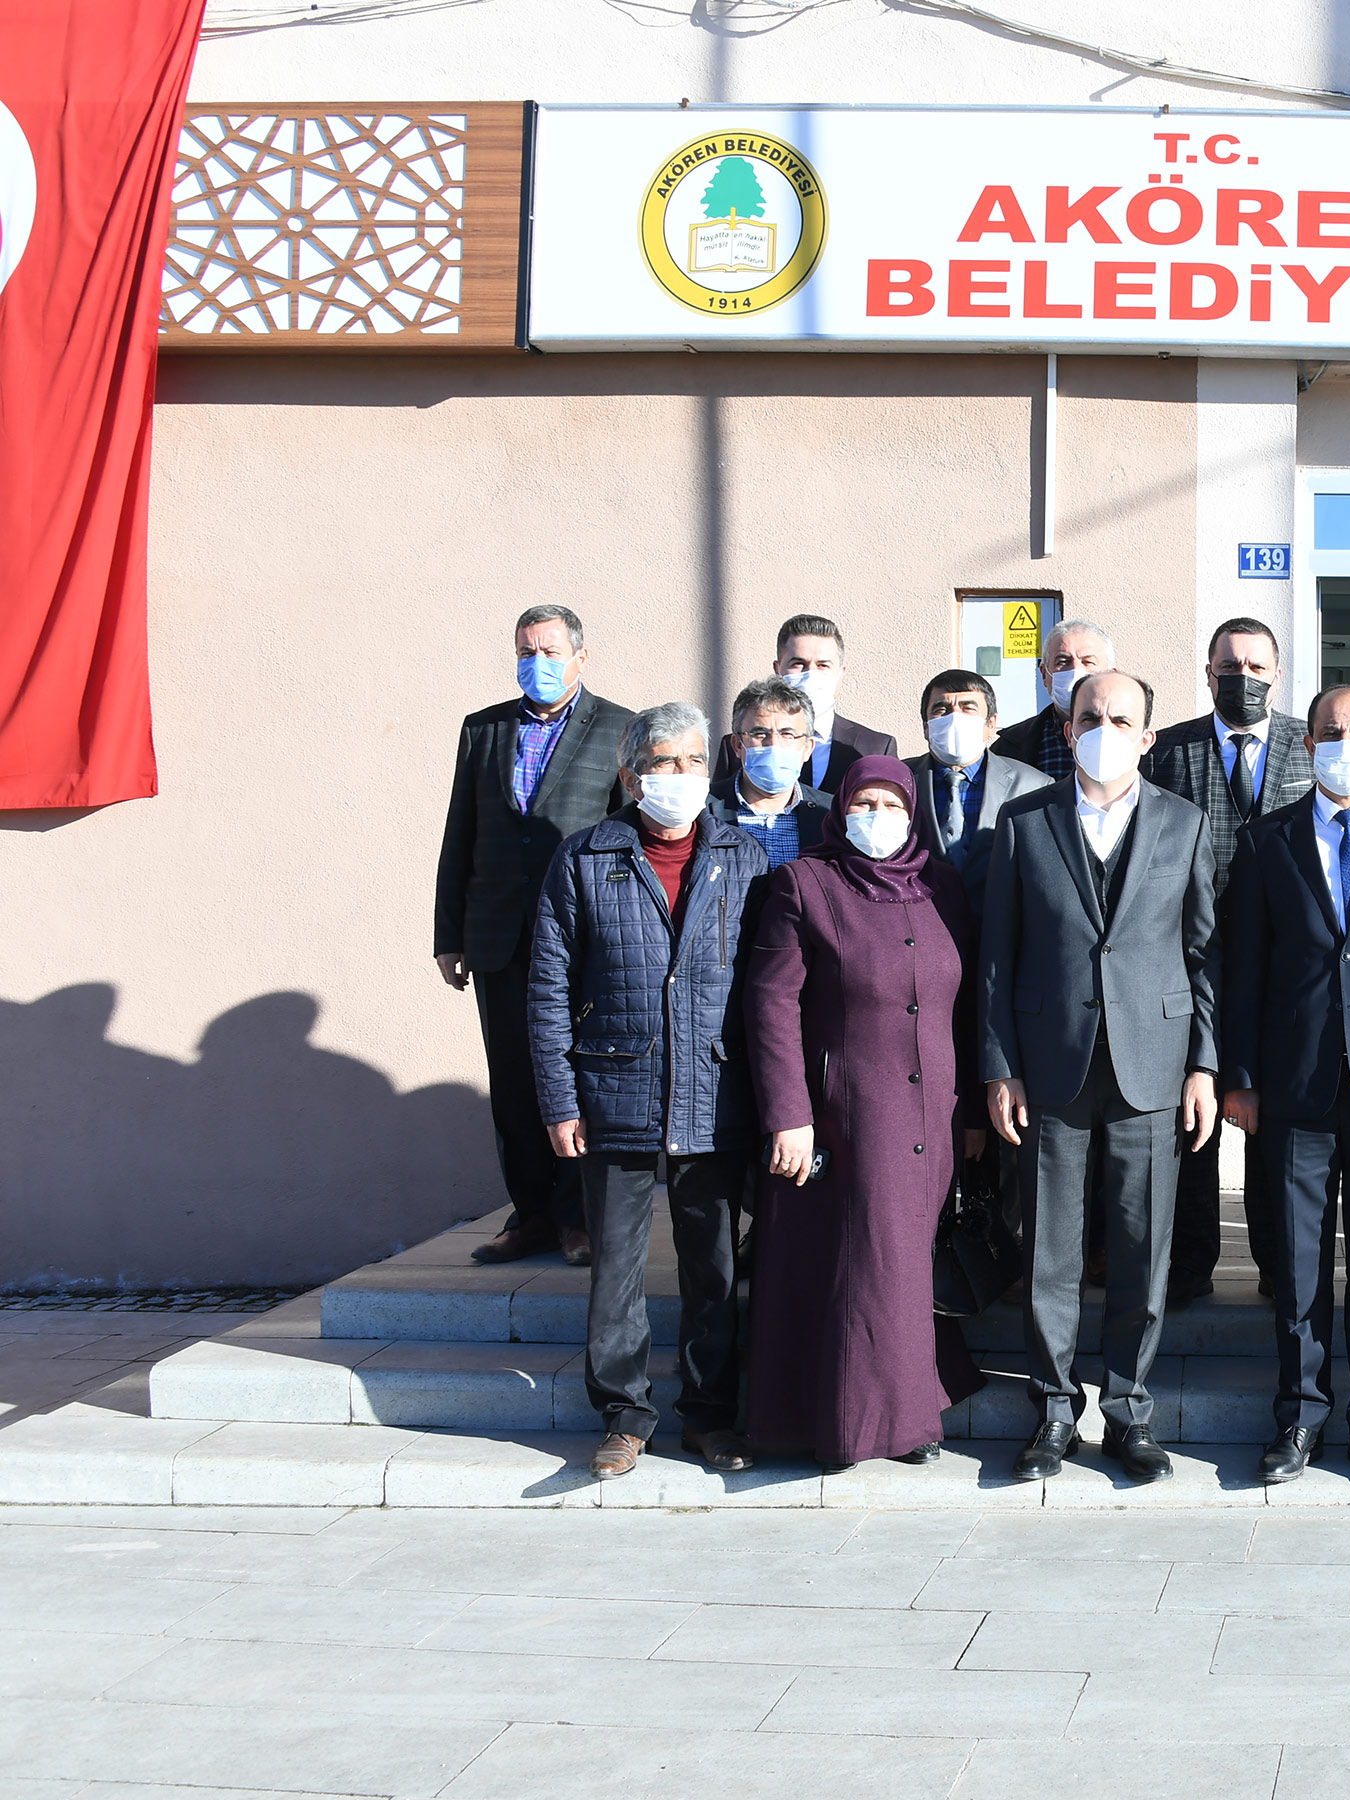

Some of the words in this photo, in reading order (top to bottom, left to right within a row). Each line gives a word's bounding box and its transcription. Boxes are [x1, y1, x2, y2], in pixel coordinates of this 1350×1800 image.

[1153, 132, 1259, 165] T.C.
[656, 142, 718, 199] AKÖREN
[725, 139, 818, 198] BELEDİYESİ
[700, 232, 729, 242] Hayatta
[709, 297, 751, 309] 1914
[1246, 548, 1285, 571] 139
